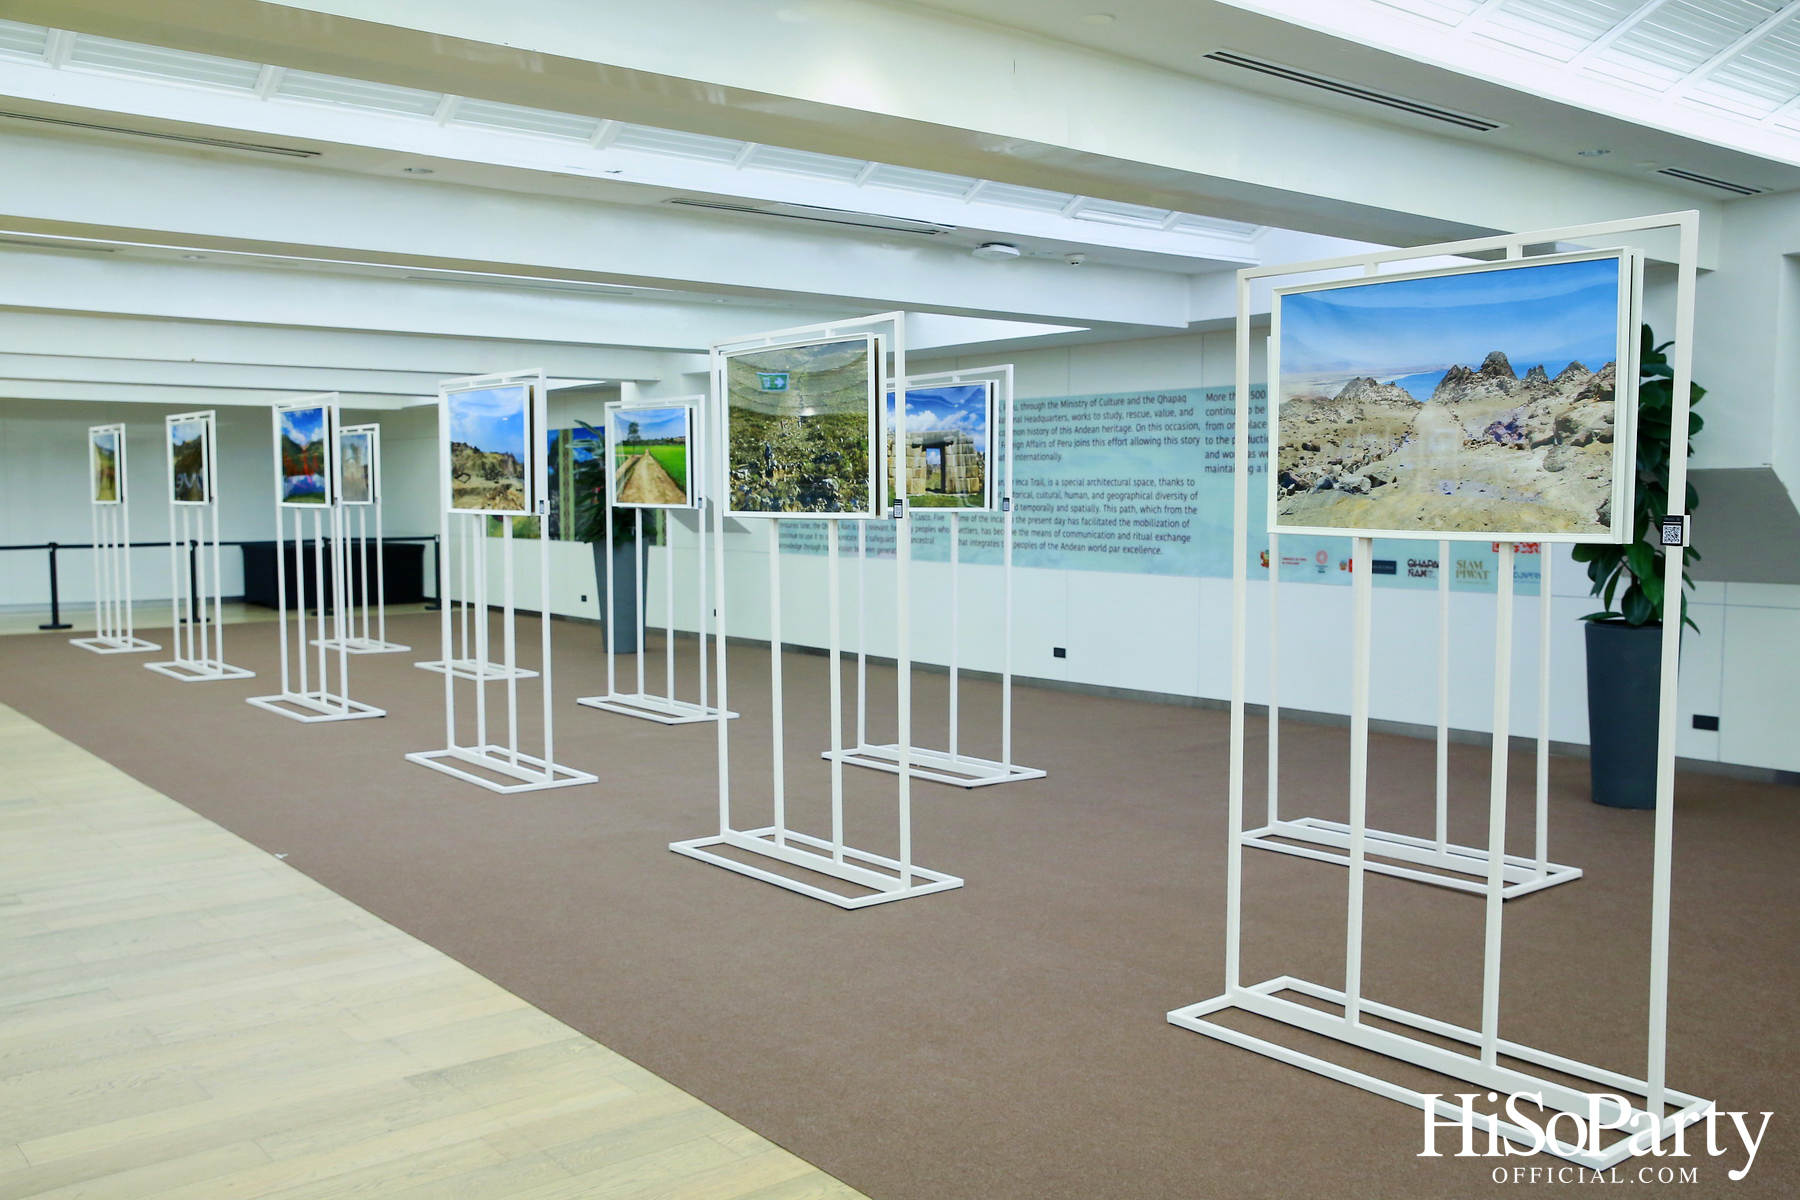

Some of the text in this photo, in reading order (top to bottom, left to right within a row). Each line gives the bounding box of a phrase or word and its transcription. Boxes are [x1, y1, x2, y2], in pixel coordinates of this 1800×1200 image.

[1206, 392, 1226, 401] More
[1020, 402, 1046, 412] through
[1048, 401, 1058, 409] the
[1060, 400, 1088, 409] Ministry
[1090, 398, 1097, 407] of
[1099, 397, 1124, 406] Culture
[1127, 396, 1140, 405] and
[1143, 396, 1155, 404] the
[1157, 394, 1186, 404] Qhapaq
[1255, 405, 1265, 414] be
[1024, 414, 1069, 424] Headquarters,
[1072, 413, 1091, 421] works
[1093, 412, 1100, 420] to
[1103, 411, 1124, 421] study,
[1126, 410, 1152, 419] rescue,
[1154, 409, 1176, 418] value,
[1179, 408, 1194, 416] and
[1027, 426, 1049, 436] history
[1051, 426, 1058, 434] of
[1060, 426, 1072, 434] this
[1074, 425, 1099, 434] Andean
[1102, 424, 1133, 435] heritage.
[1136, 424, 1146, 432] On
[1148, 422, 1162, 431] this
[1165, 422, 1200, 432] occasion,
[1205, 422, 1224, 430] from
[1026, 440, 1046, 448] Affairs
[1049, 439, 1056, 447] of
[1074, 439, 1090, 448] joins
[1108, 438, 1128, 447] effort
[1130, 437, 1161, 447] allowing
[1164, 436, 1178, 445] this
[1180, 436, 1200, 446] story
[1216, 435, 1229, 444] the
[1014, 453, 1063, 462] internationally.
[1205, 450, 1219, 459] and
[1030, 479, 1046, 487] Trail,
[1061, 478, 1084, 488] special
[1086, 478, 1131, 486] architectural
[1133, 479, 1156, 488] space,
[1159, 478, 1184, 486] thanks
[1036, 491, 1062, 500] cultural,
[1064, 492, 1089, 500] human,
[1092, 491, 1104, 499] and
[1106, 492, 1153, 501] geographical
[1155, 491, 1188, 502] diversity
[1190, 491, 1198, 500] of
[1020, 504, 1054, 513] temporally
[1070, 504, 1100, 513] spatially.
[1103, 504, 1117, 512] This
[1119, 504, 1137, 514] path,
[1140, 505, 1161, 514] which
[1164, 505, 1182, 514] from
[1184, 506, 1197, 514] the
[1028, 516, 1052, 525] present
[1054, 517, 1065, 527] day
[1067, 517, 1079, 525] has
[1081, 517, 1117, 526] facilitated
[1119, 518, 1131, 527] the
[1133, 519, 1180, 528] mobilization
[1182, 519, 1190, 528] of
[1062, 530, 1115, 539] communication
[1118, 532, 1131, 540] and
[1133, 532, 1152, 541] ritual
[1155, 533, 1191, 544] exchange
[1013, 541, 1037, 550] peoples
[1039, 542, 1046, 550] of
[1048, 542, 1058, 550] the
[1060, 542, 1086, 551] Andean
[1088, 544, 1107, 552] world
[1109, 545, 1120, 553] par
[1122, 545, 1163, 555] excellence.
